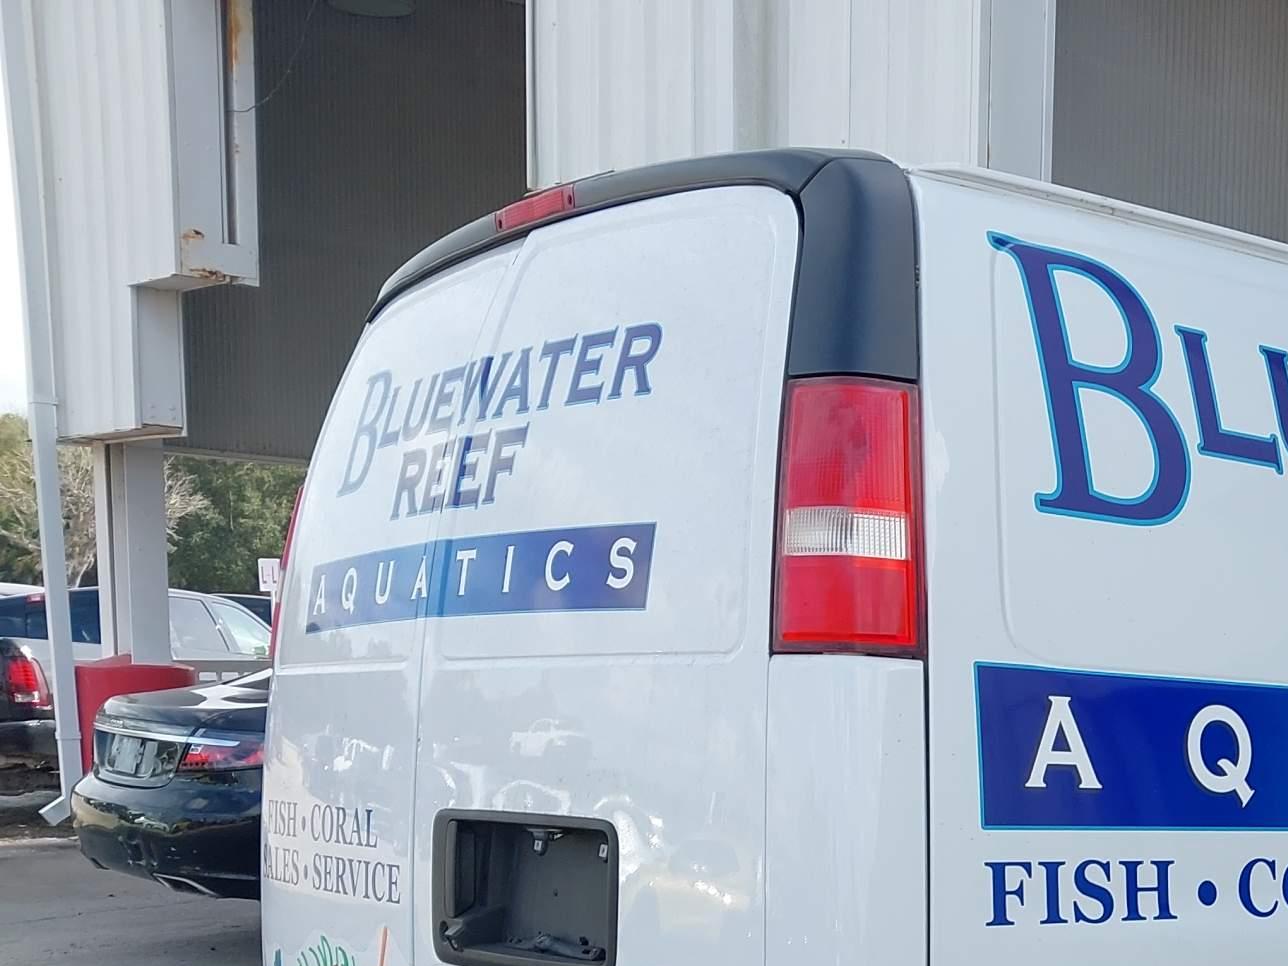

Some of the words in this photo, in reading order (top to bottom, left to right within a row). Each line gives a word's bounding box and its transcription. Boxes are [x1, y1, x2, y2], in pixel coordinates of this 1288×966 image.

[336, 322, 663, 498] BLUEWATER
[390, 422, 530, 521] REEF
[313, 537, 638, 615] AQUATICS
[268, 799, 298, 837] FISH
[310, 803, 378, 848] CORAL
[263, 842, 300, 886] SALES
[312, 853, 401, 904] SERVICE
[984, 858, 1177, 926] FISH
